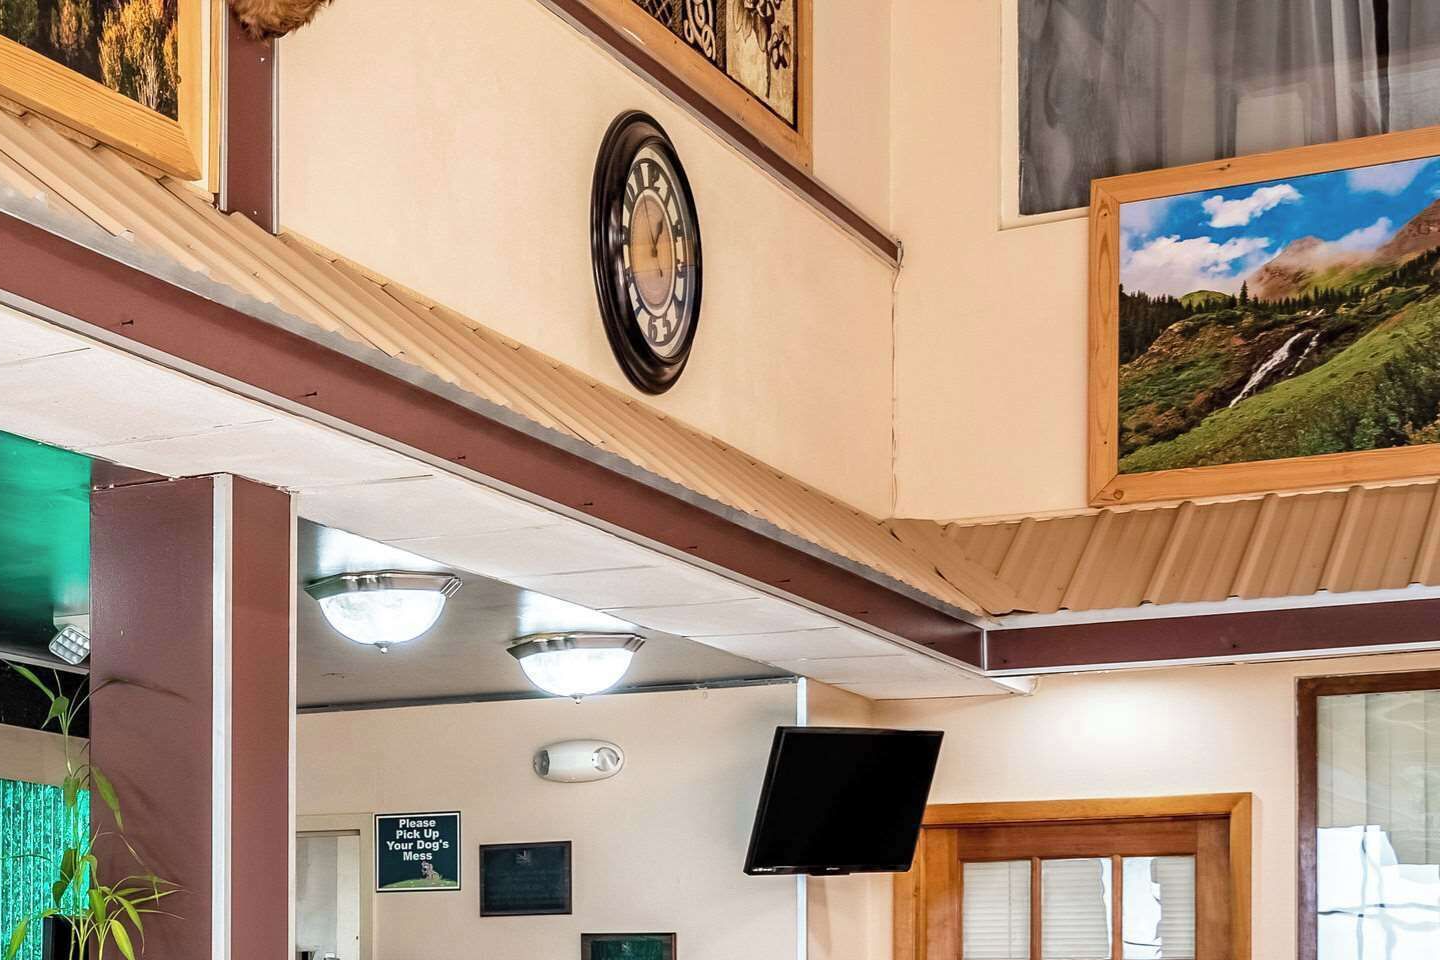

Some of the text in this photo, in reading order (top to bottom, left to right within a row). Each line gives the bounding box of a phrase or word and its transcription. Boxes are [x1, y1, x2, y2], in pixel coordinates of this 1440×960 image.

[399, 819, 436, 828] Please
[396, 828, 440, 840] Pick Up
[386, 839, 449, 851] Your Dog's
[403, 851, 433, 861] Mess
